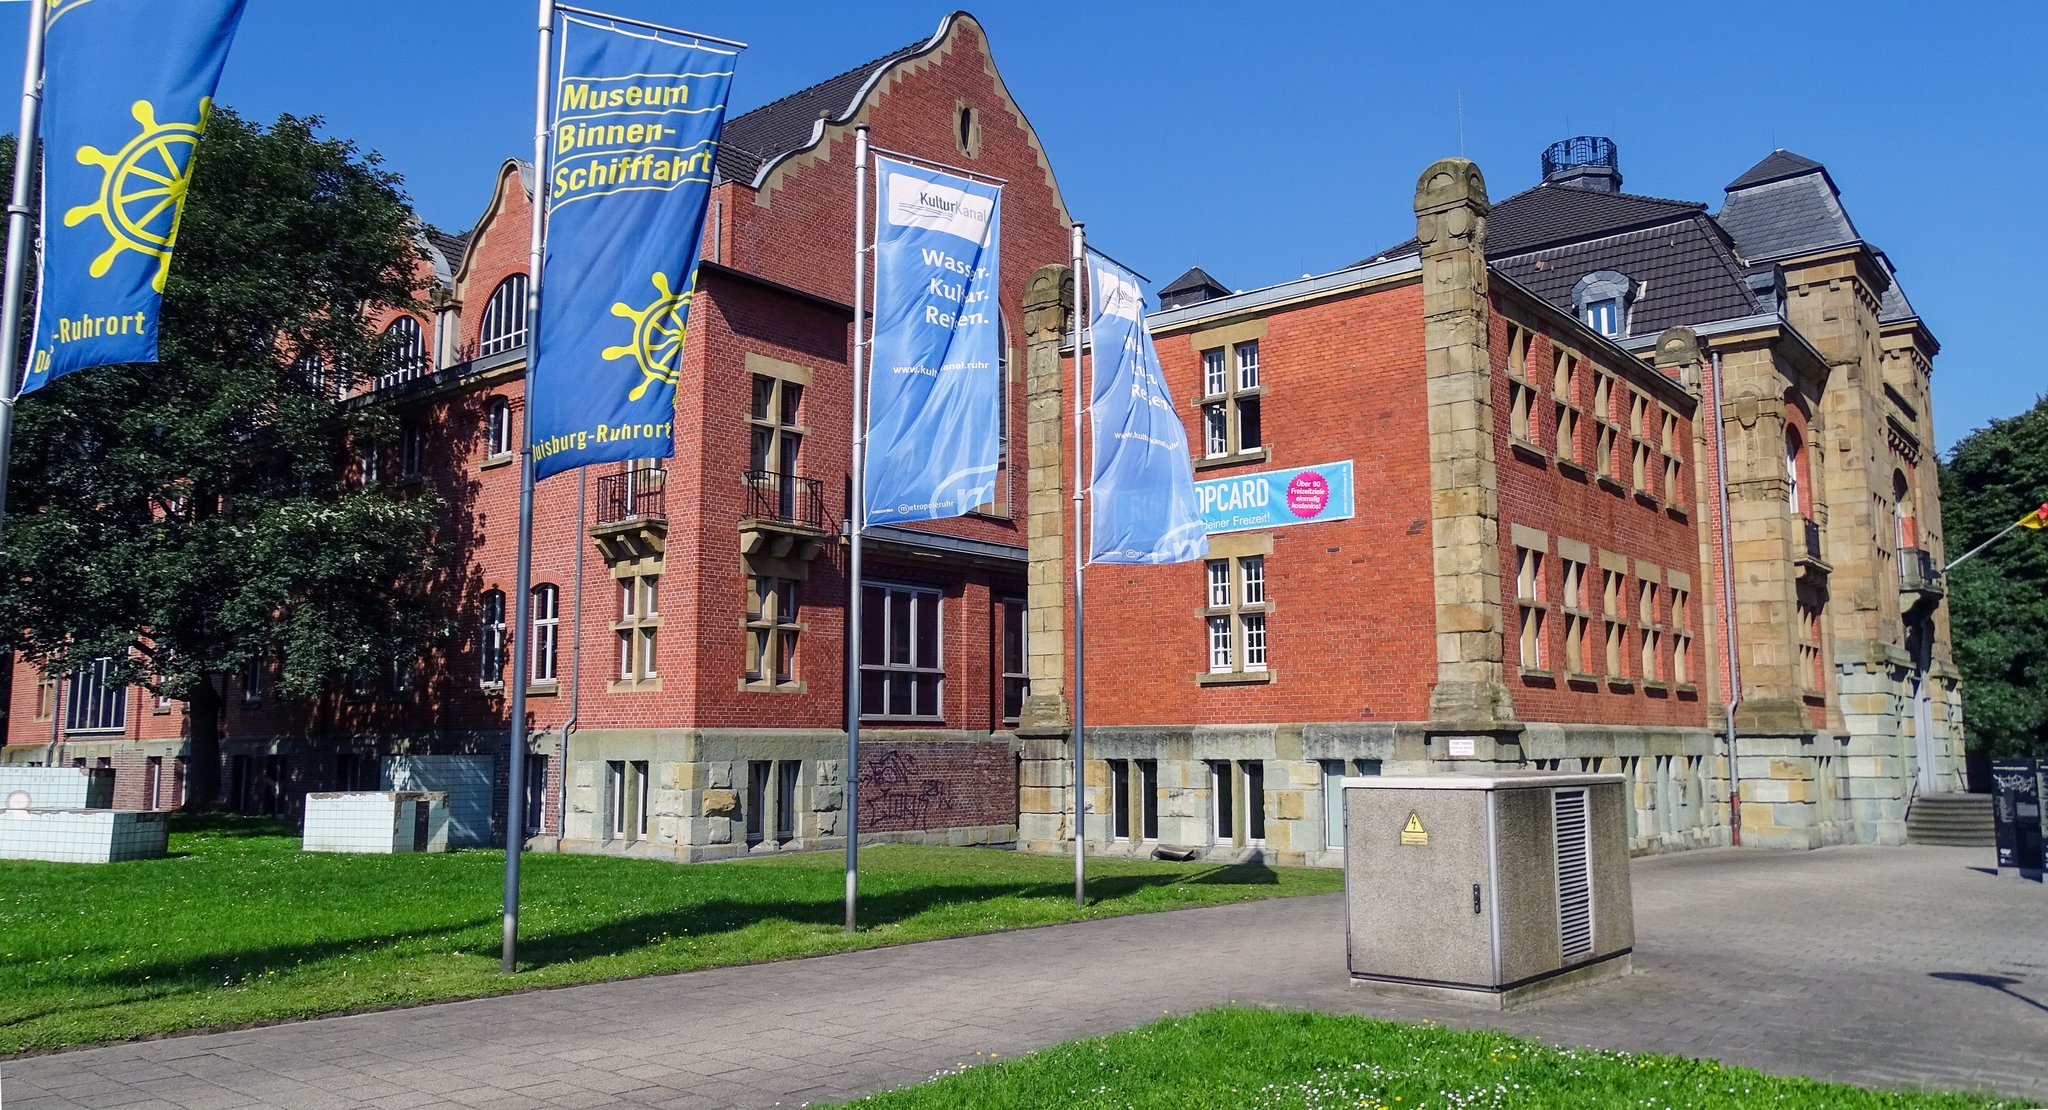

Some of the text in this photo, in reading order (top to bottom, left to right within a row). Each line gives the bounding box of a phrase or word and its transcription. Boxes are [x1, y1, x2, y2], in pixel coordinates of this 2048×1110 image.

[562, 84, 689, 112] Museum
[559, 123, 676, 155] Binnen-
[554, 149, 712, 199] Schifffahrt
[920, 192, 987, 223] KulturKanal
[926, 305, 990, 331] Reien.
[1290, 487, 1326, 495] Freizeitziele
[1296, 479, 1311, 487] Über
[1291, 502, 1322, 510] kostenlos!
[1295, 495, 1321, 503] einmalig
[1233, 512, 1271, 527] Freizeit!
